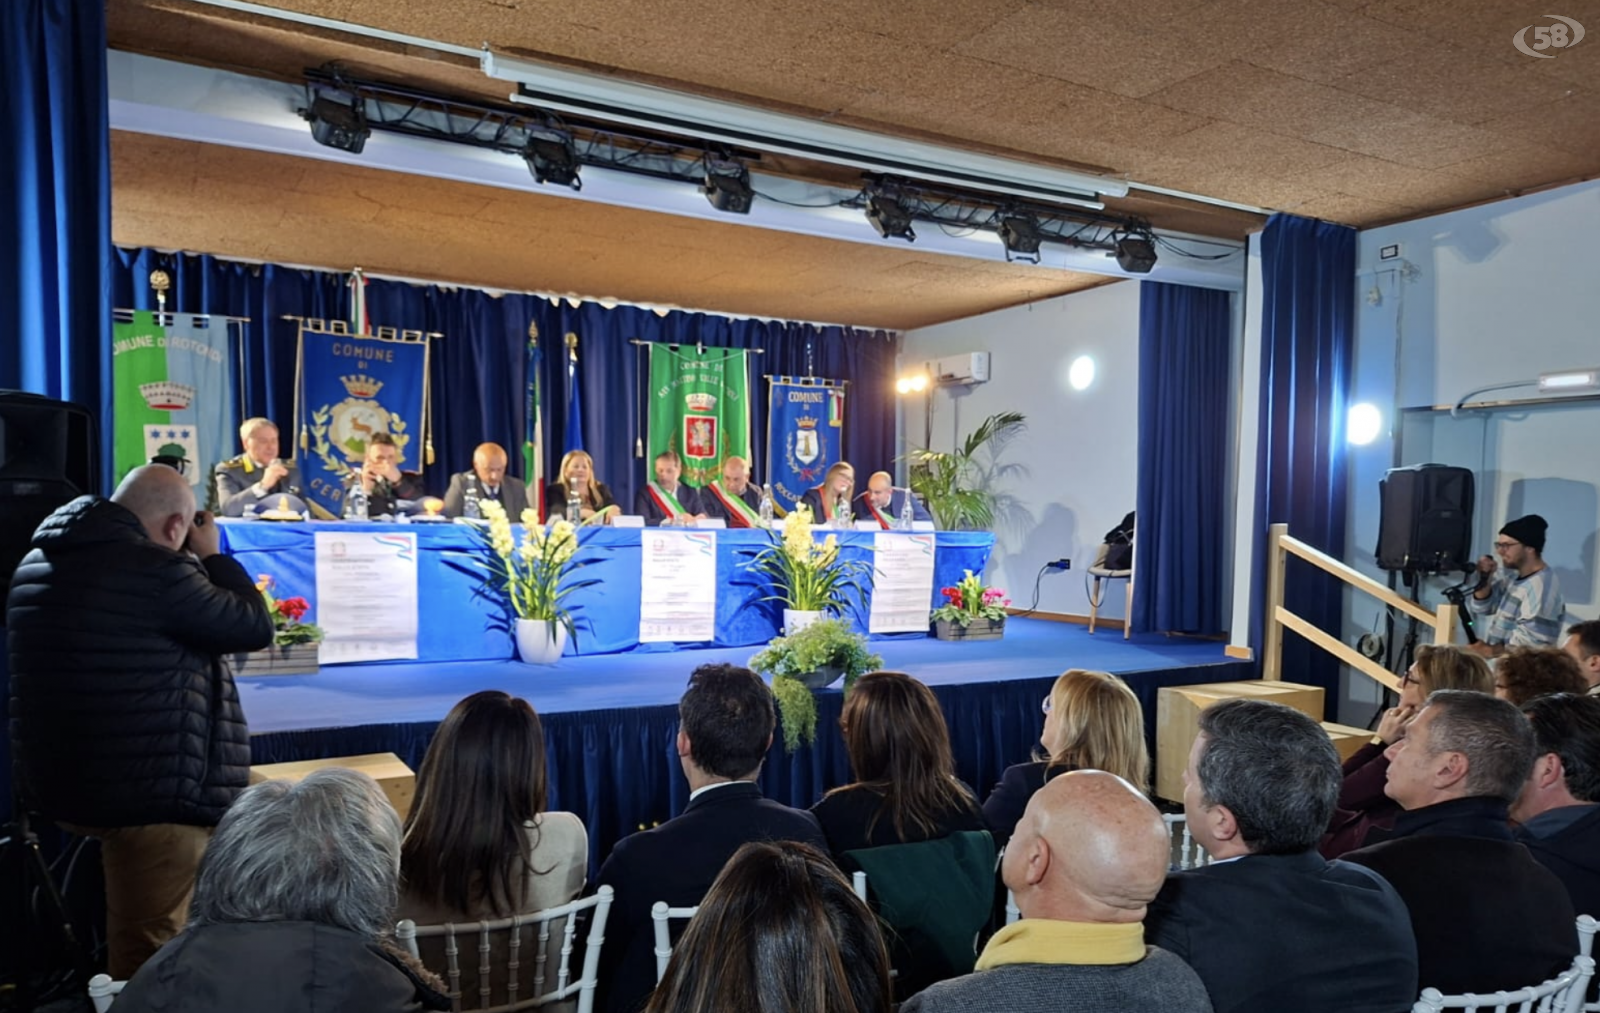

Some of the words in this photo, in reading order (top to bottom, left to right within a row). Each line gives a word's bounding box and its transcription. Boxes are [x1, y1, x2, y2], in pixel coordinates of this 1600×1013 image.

[113, 334, 154, 356] OMUNE
[332, 342, 394, 363] COMUNE
[358, 361, 368, 369] DI
[788, 391, 824, 403] COMUNE
[310, 478, 342, 502] CER
[774, 481, 802, 503] ROCCA
